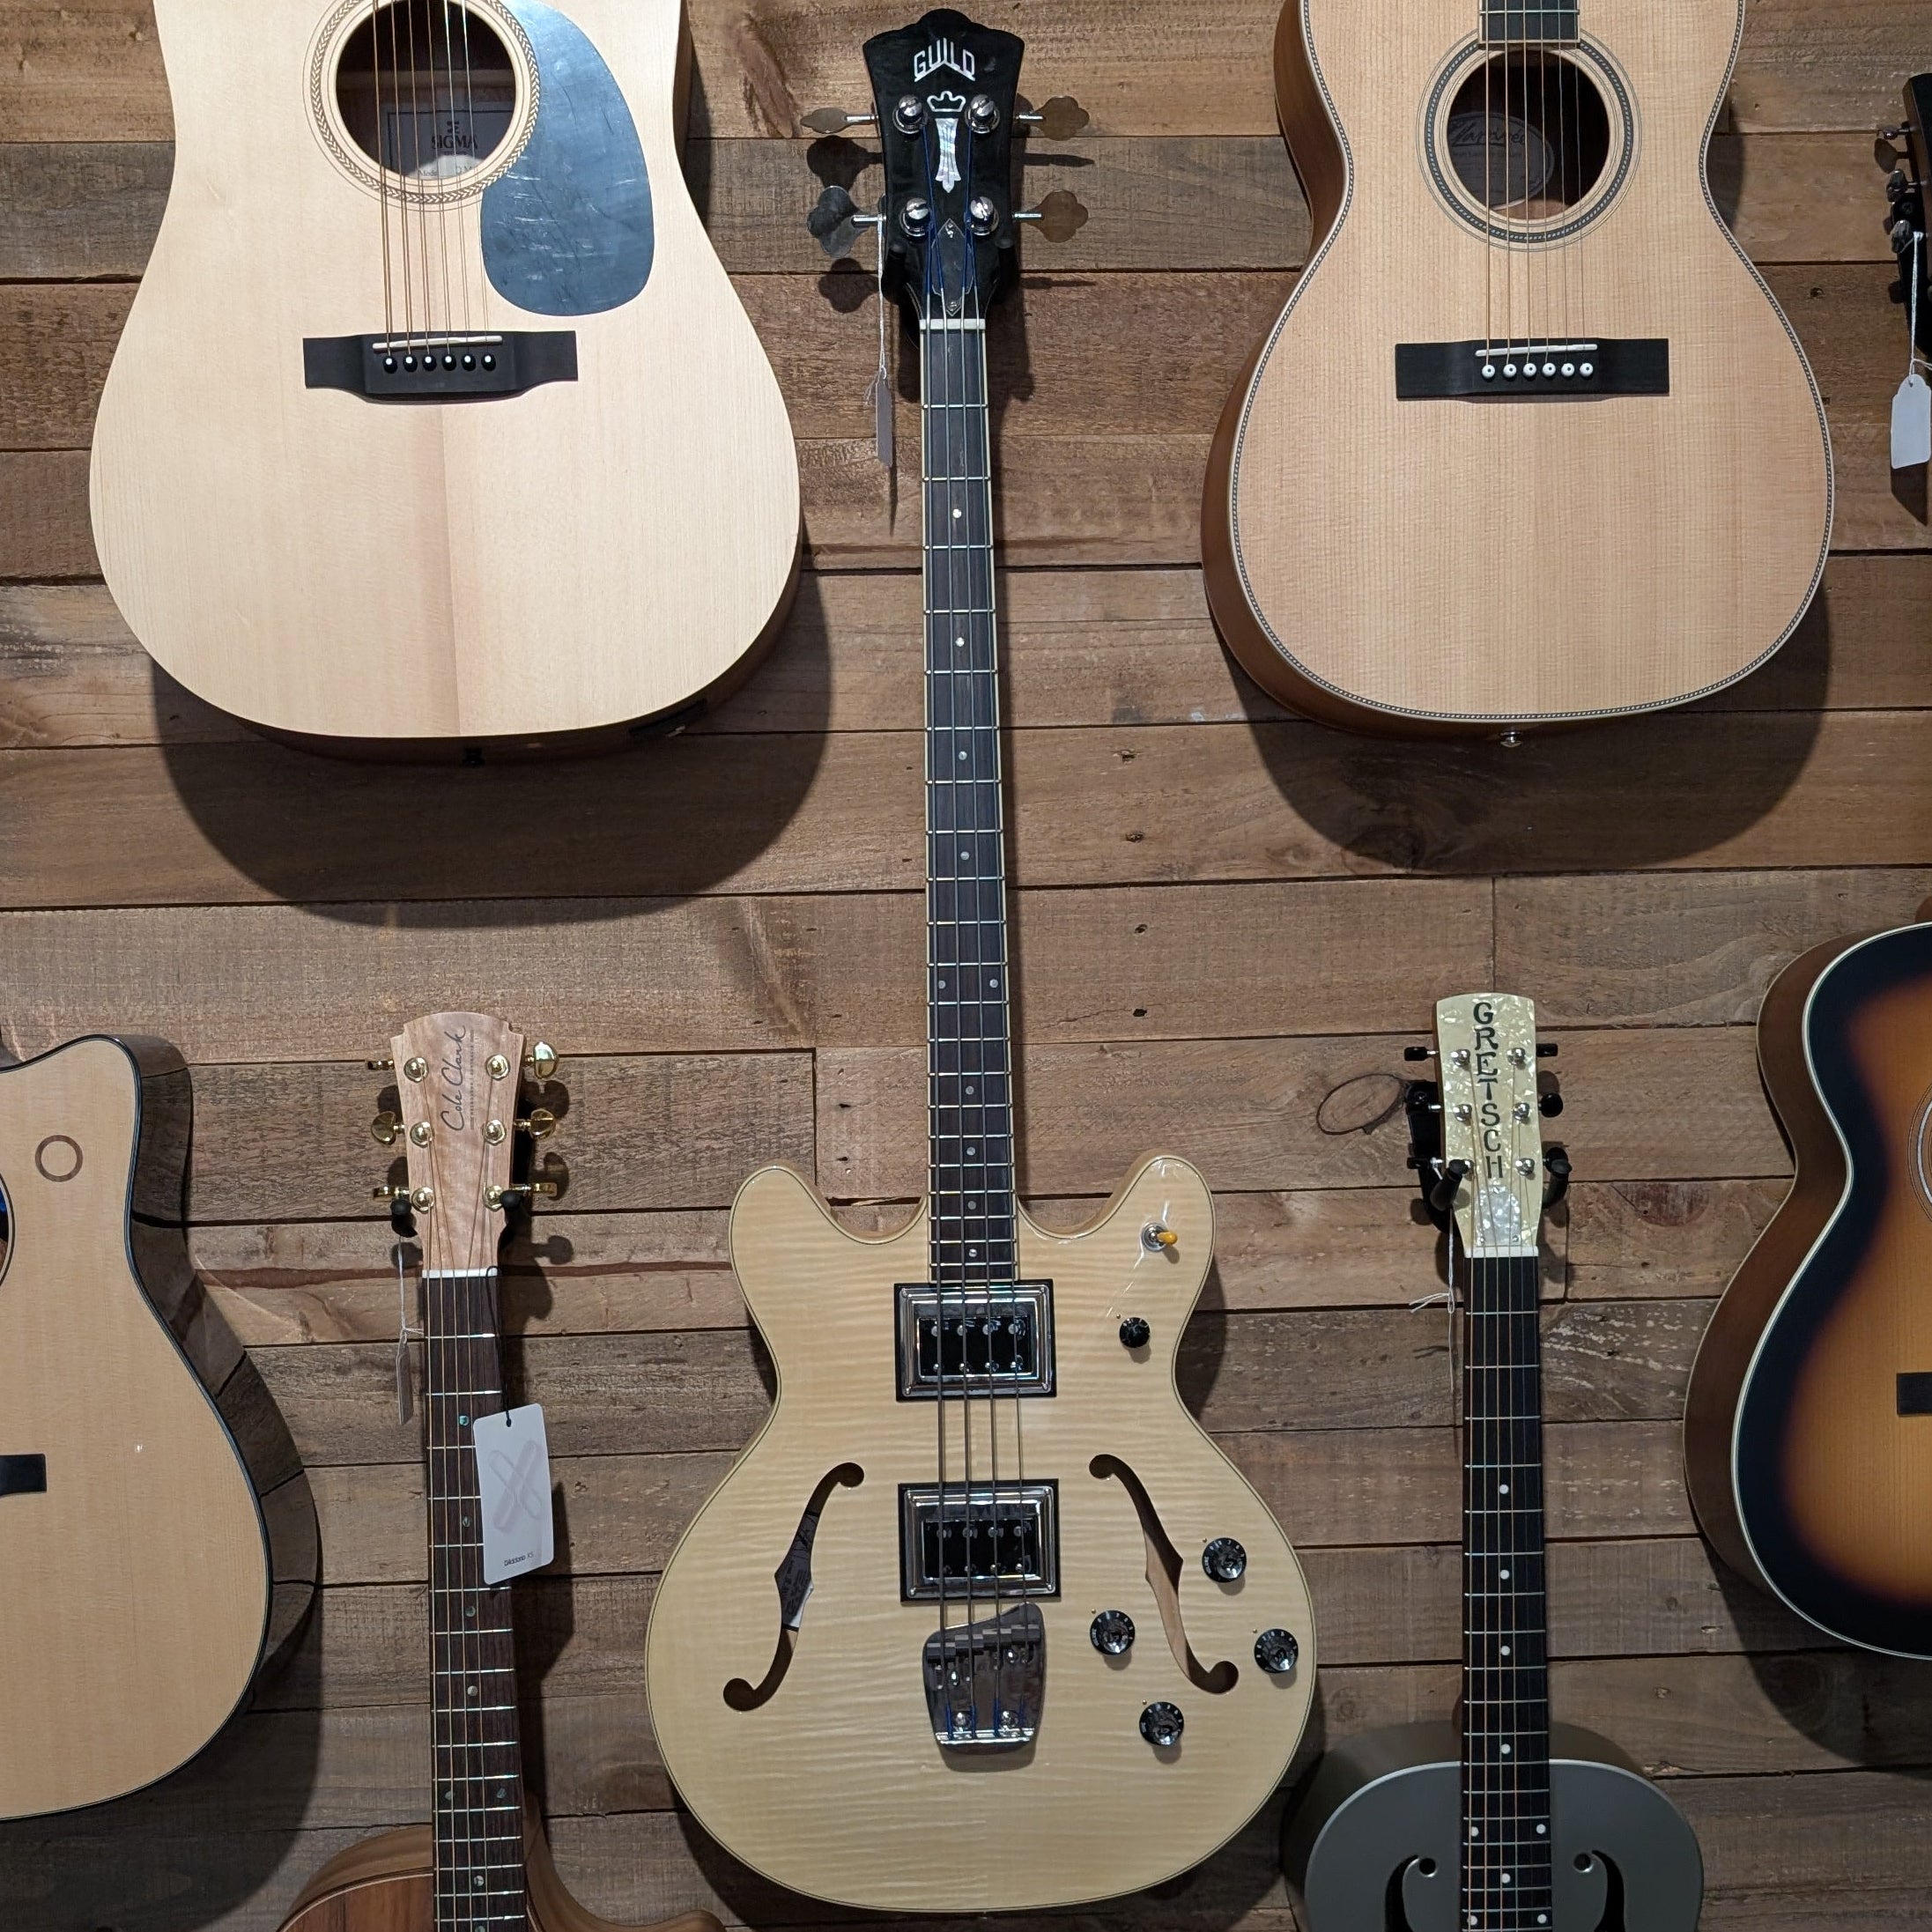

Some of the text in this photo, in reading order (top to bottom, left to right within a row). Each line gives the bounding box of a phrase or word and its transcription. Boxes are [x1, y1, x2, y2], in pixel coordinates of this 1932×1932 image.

[914, 38, 976, 82] GUILD
[431, 135, 478, 149] SIGMA
[440, 1025, 466, 1131] Cole Clark
[1473, 1002, 1503, 1179] GRETSCH
